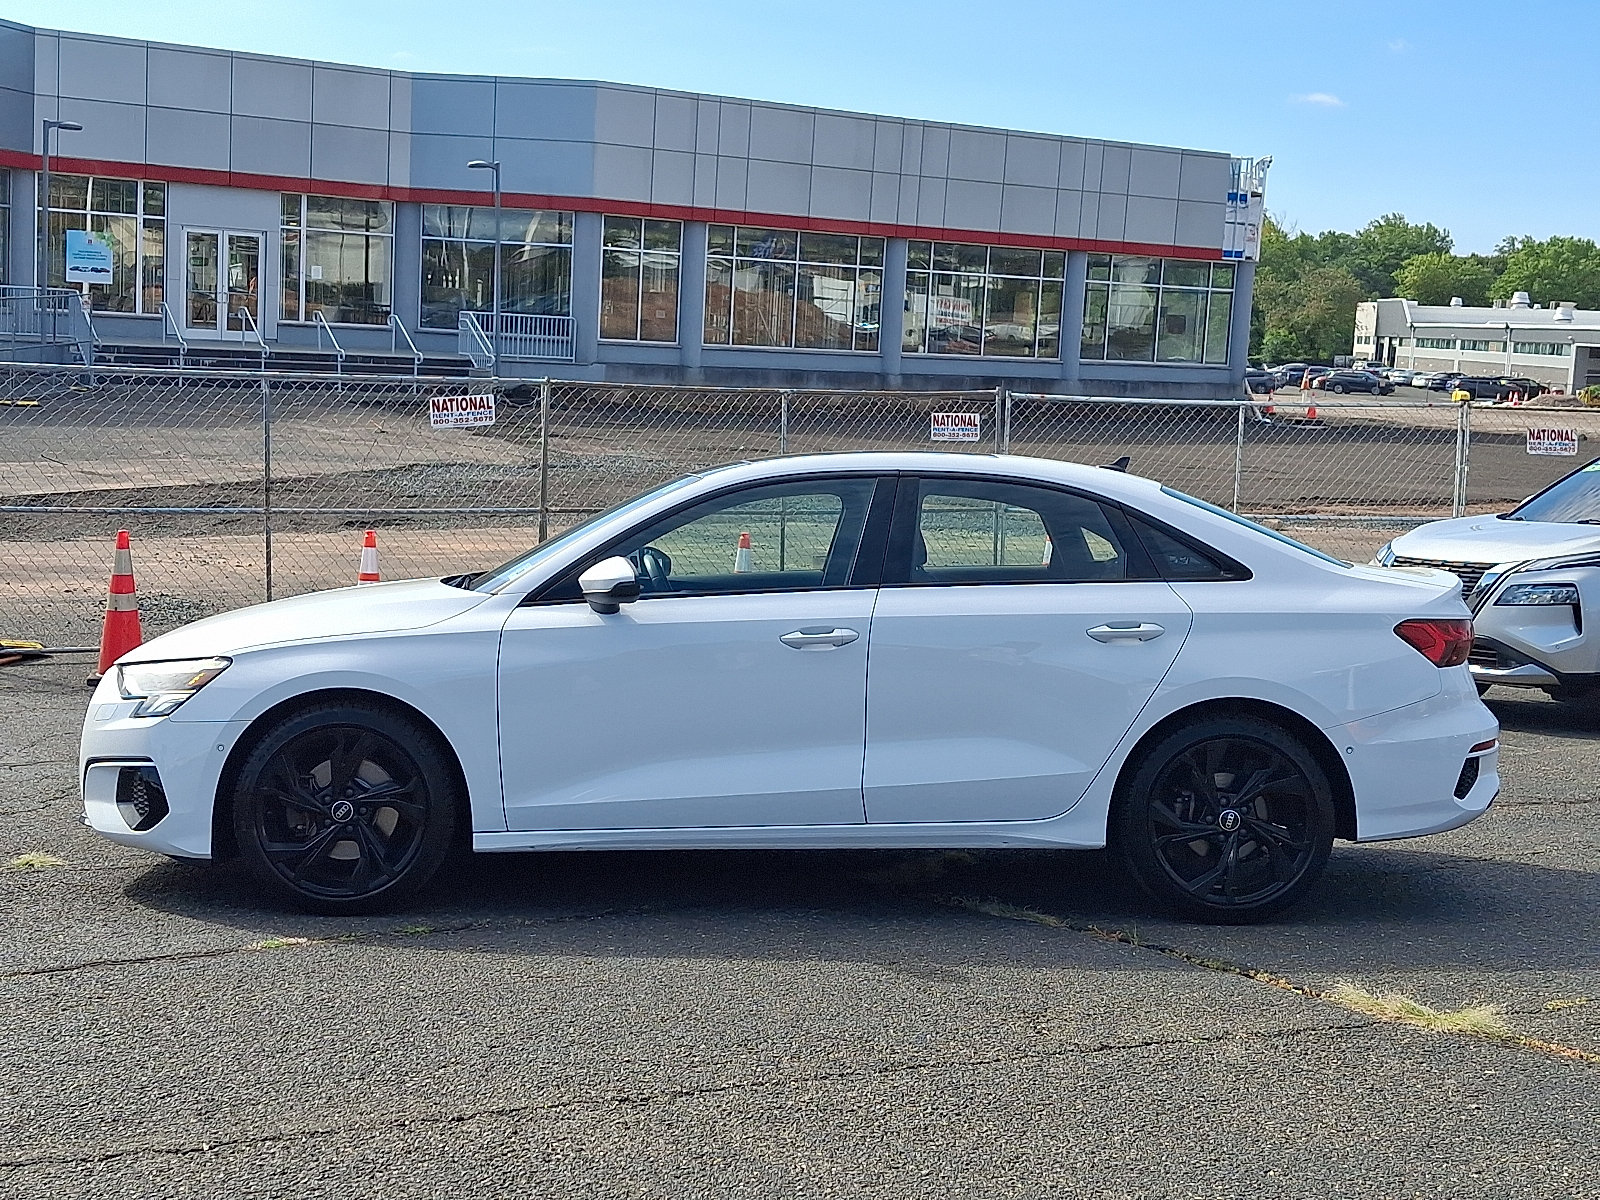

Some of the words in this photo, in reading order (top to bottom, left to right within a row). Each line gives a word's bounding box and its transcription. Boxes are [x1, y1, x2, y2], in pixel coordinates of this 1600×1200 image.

[431, 396, 493, 413] NATIONAL
[432, 410, 494, 419] RENT-A-FENCE
[933, 414, 978, 427] NATIONAL
[1529, 429, 1576, 442] NATIONAL
